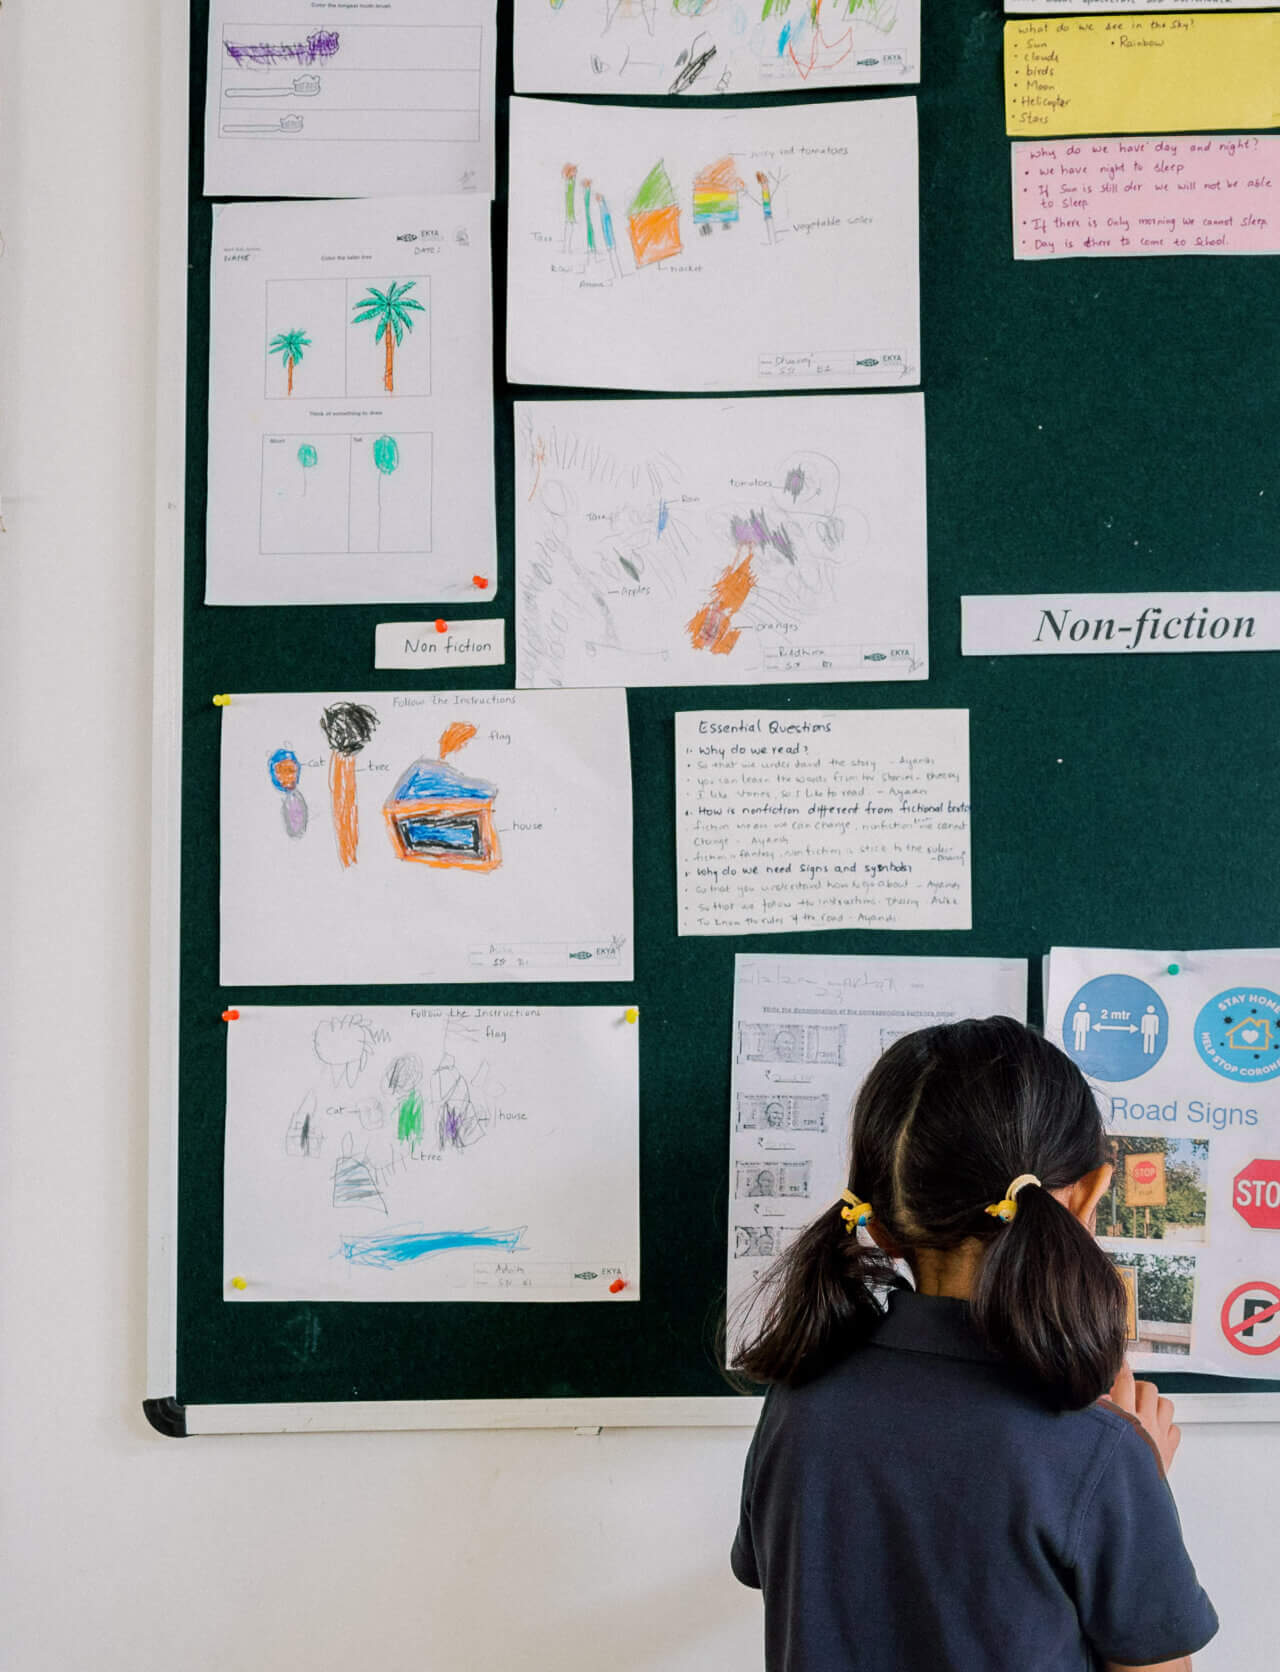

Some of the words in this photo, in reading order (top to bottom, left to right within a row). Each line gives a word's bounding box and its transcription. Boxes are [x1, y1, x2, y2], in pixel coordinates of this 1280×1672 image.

[1033, 607, 1256, 649] Non-fiction
[1102, 1010, 1108, 1019] 2
[1112, 1010, 1130, 1020] mtr
[1218, 994, 1246, 1012] STAY
[1202, 1032, 1216, 1056] HELP
[1213, 1056, 1238, 1074] STOP
[1111, 1098, 1176, 1122] Road
[1188, 1101, 1258, 1130] Signs
[1133, 1167, 1155, 1177] STOP
